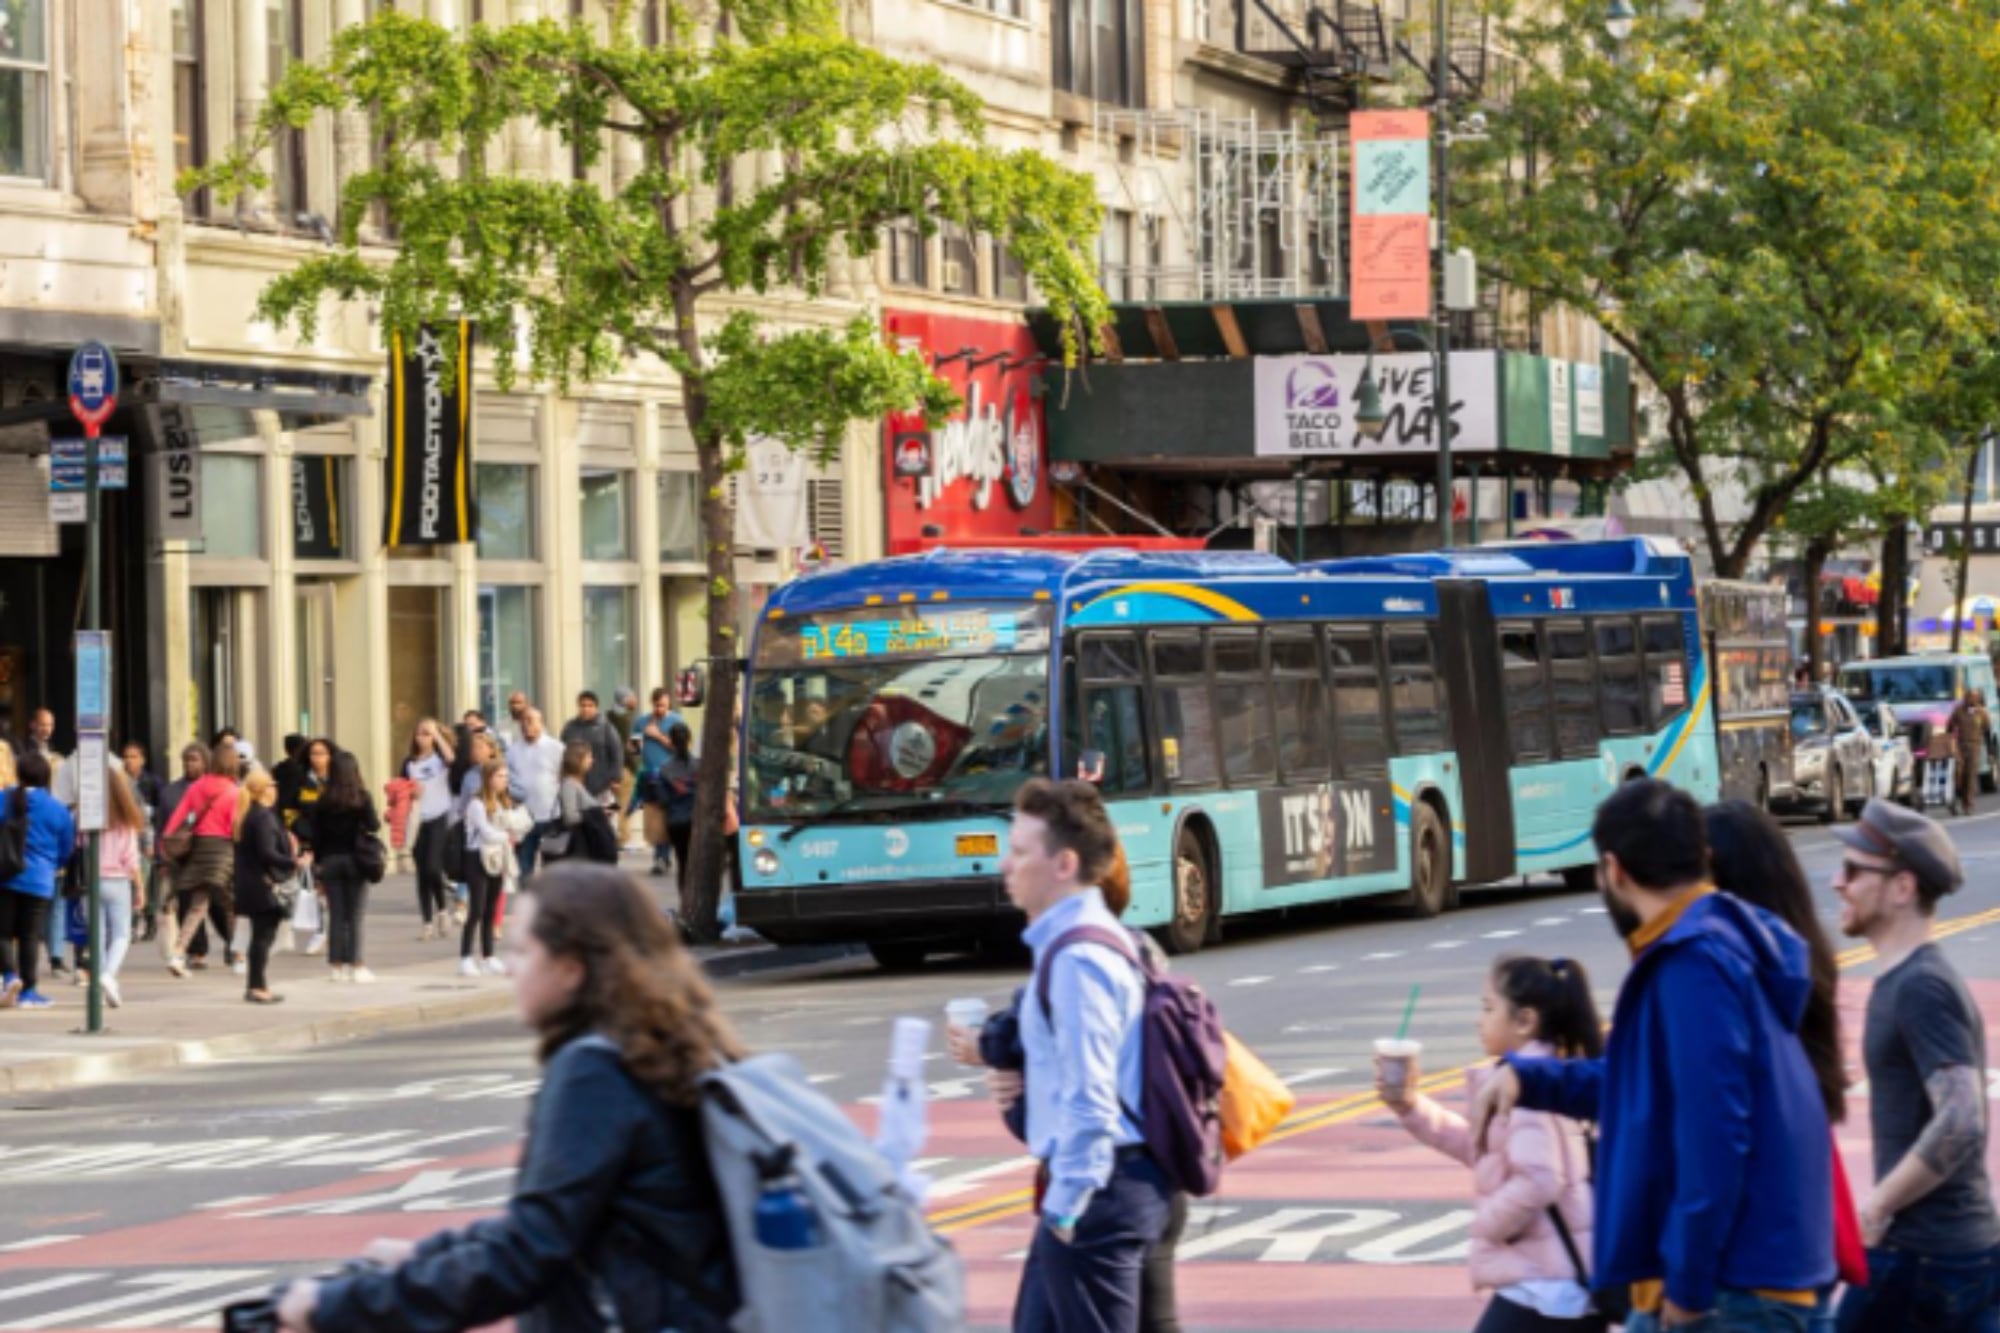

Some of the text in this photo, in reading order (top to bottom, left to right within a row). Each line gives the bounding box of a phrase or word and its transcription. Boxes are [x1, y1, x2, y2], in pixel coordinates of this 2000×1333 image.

[1285, 412, 1341, 430] TACO
[1288, 431, 1341, 449] BELL
[420, 371, 443, 539] FOOTACTION
